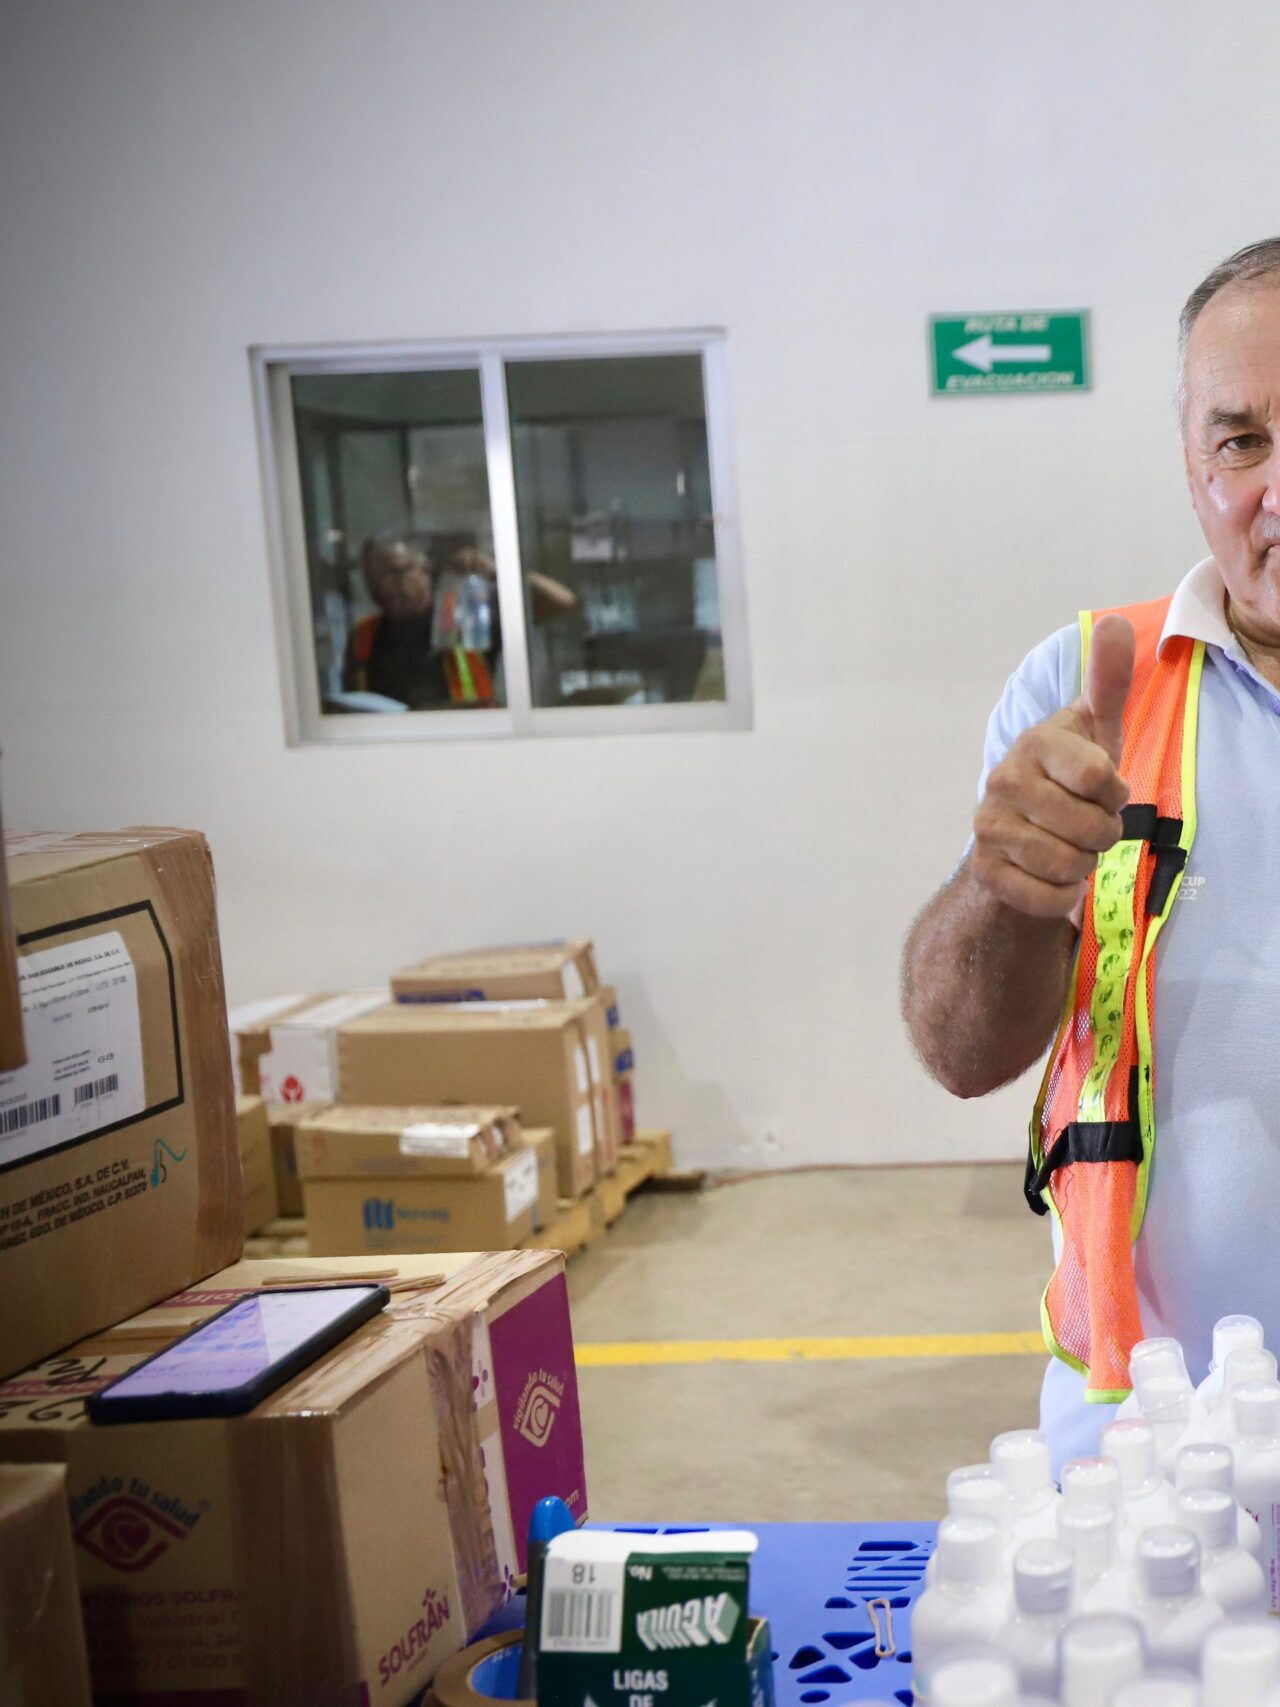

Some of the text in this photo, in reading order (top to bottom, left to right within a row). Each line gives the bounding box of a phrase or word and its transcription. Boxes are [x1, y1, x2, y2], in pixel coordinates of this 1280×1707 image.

[964, 314, 1049, 334] RUTA DE
[96, 1167, 110, 1182] DE
[112, 1159, 129, 1175] C.V.
[151, 1490, 200, 1529] salud
[572, 1564, 597, 1585] 18
[612, 1668, 670, 1692] LIGAS
